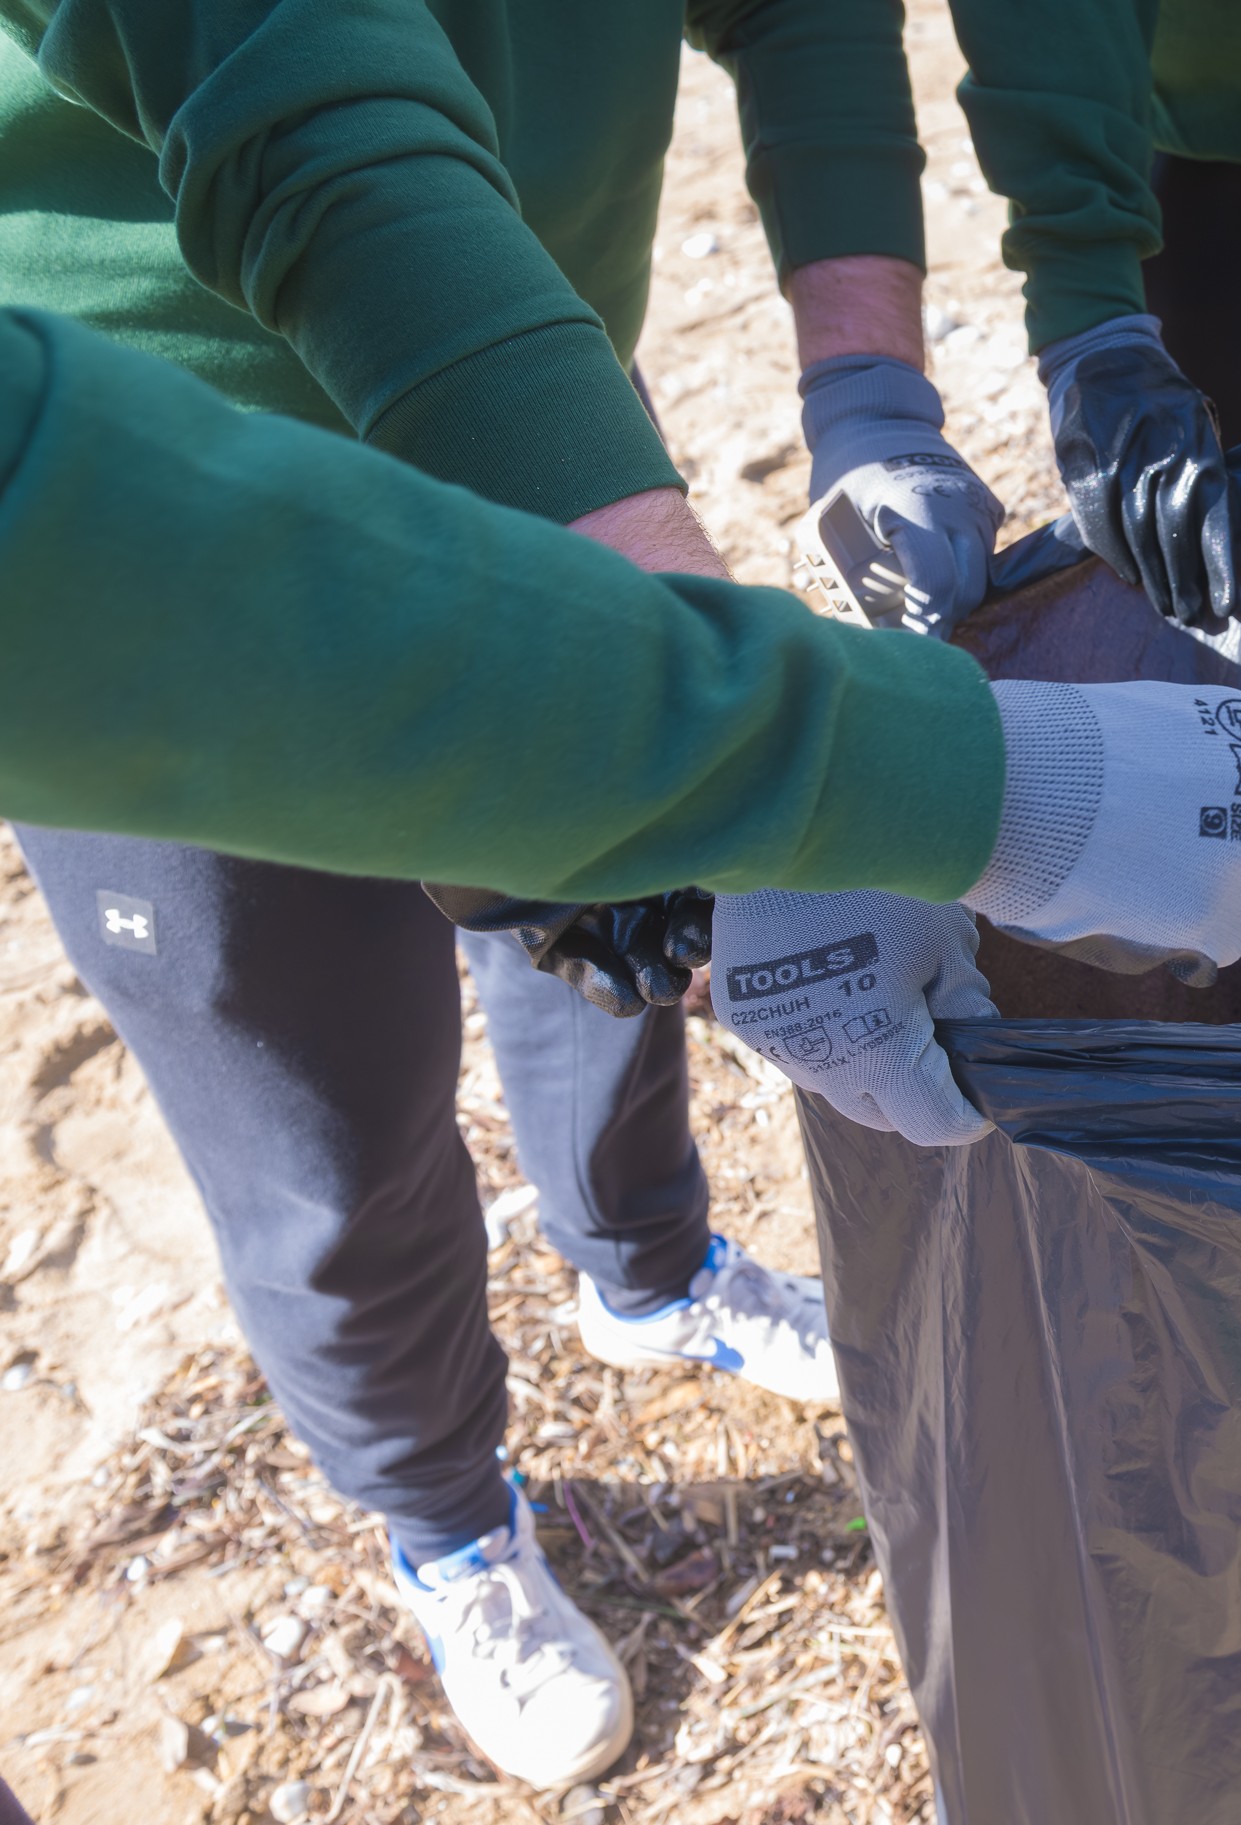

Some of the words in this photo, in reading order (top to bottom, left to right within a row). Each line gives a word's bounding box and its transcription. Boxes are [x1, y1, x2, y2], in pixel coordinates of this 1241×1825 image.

[1194, 698, 1219, 736] 4121
[735, 947, 856, 996] TOOLS
[731, 996, 811, 1027] C22CHUH
[838, 973, 877, 998] 10
